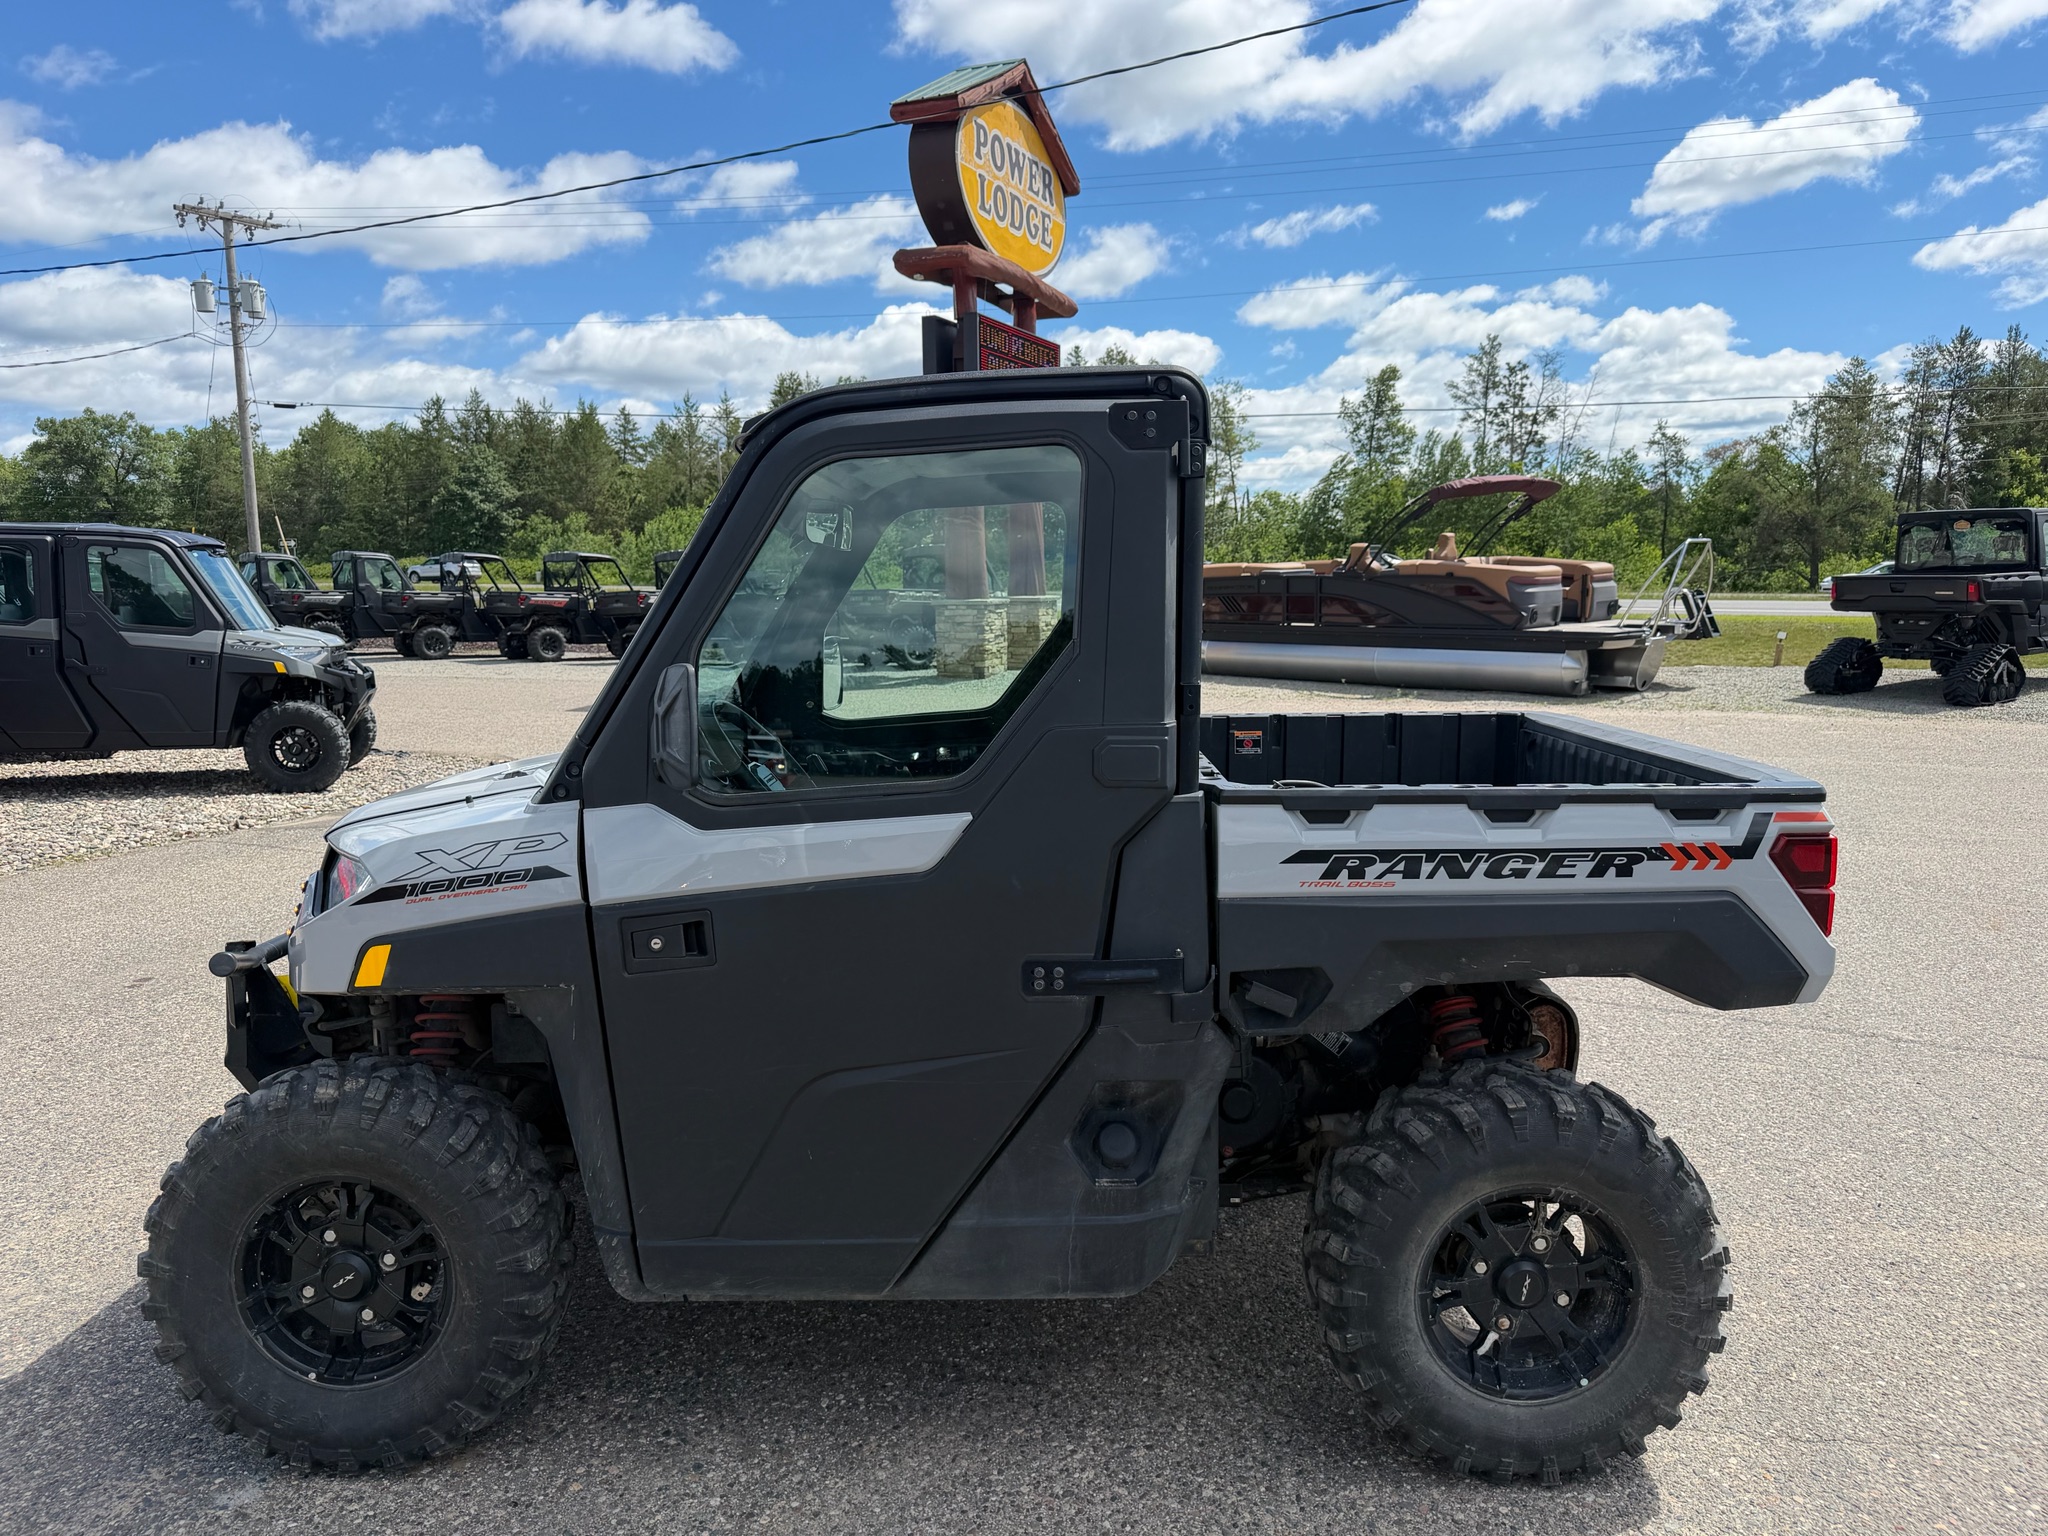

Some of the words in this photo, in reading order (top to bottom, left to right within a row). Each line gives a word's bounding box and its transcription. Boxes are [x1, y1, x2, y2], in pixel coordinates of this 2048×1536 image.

[973, 117, 1055, 208] POWER
[977, 171, 1053, 251] LODGE
[384, 831, 569, 884] XP
[1317, 850, 1648, 881] RANGER
[404, 867, 535, 898] 1000
[405, 896, 435, 905] DUAL
[438, 887, 499, 900] OVERHEAD
[501, 884, 528, 892] CAM
